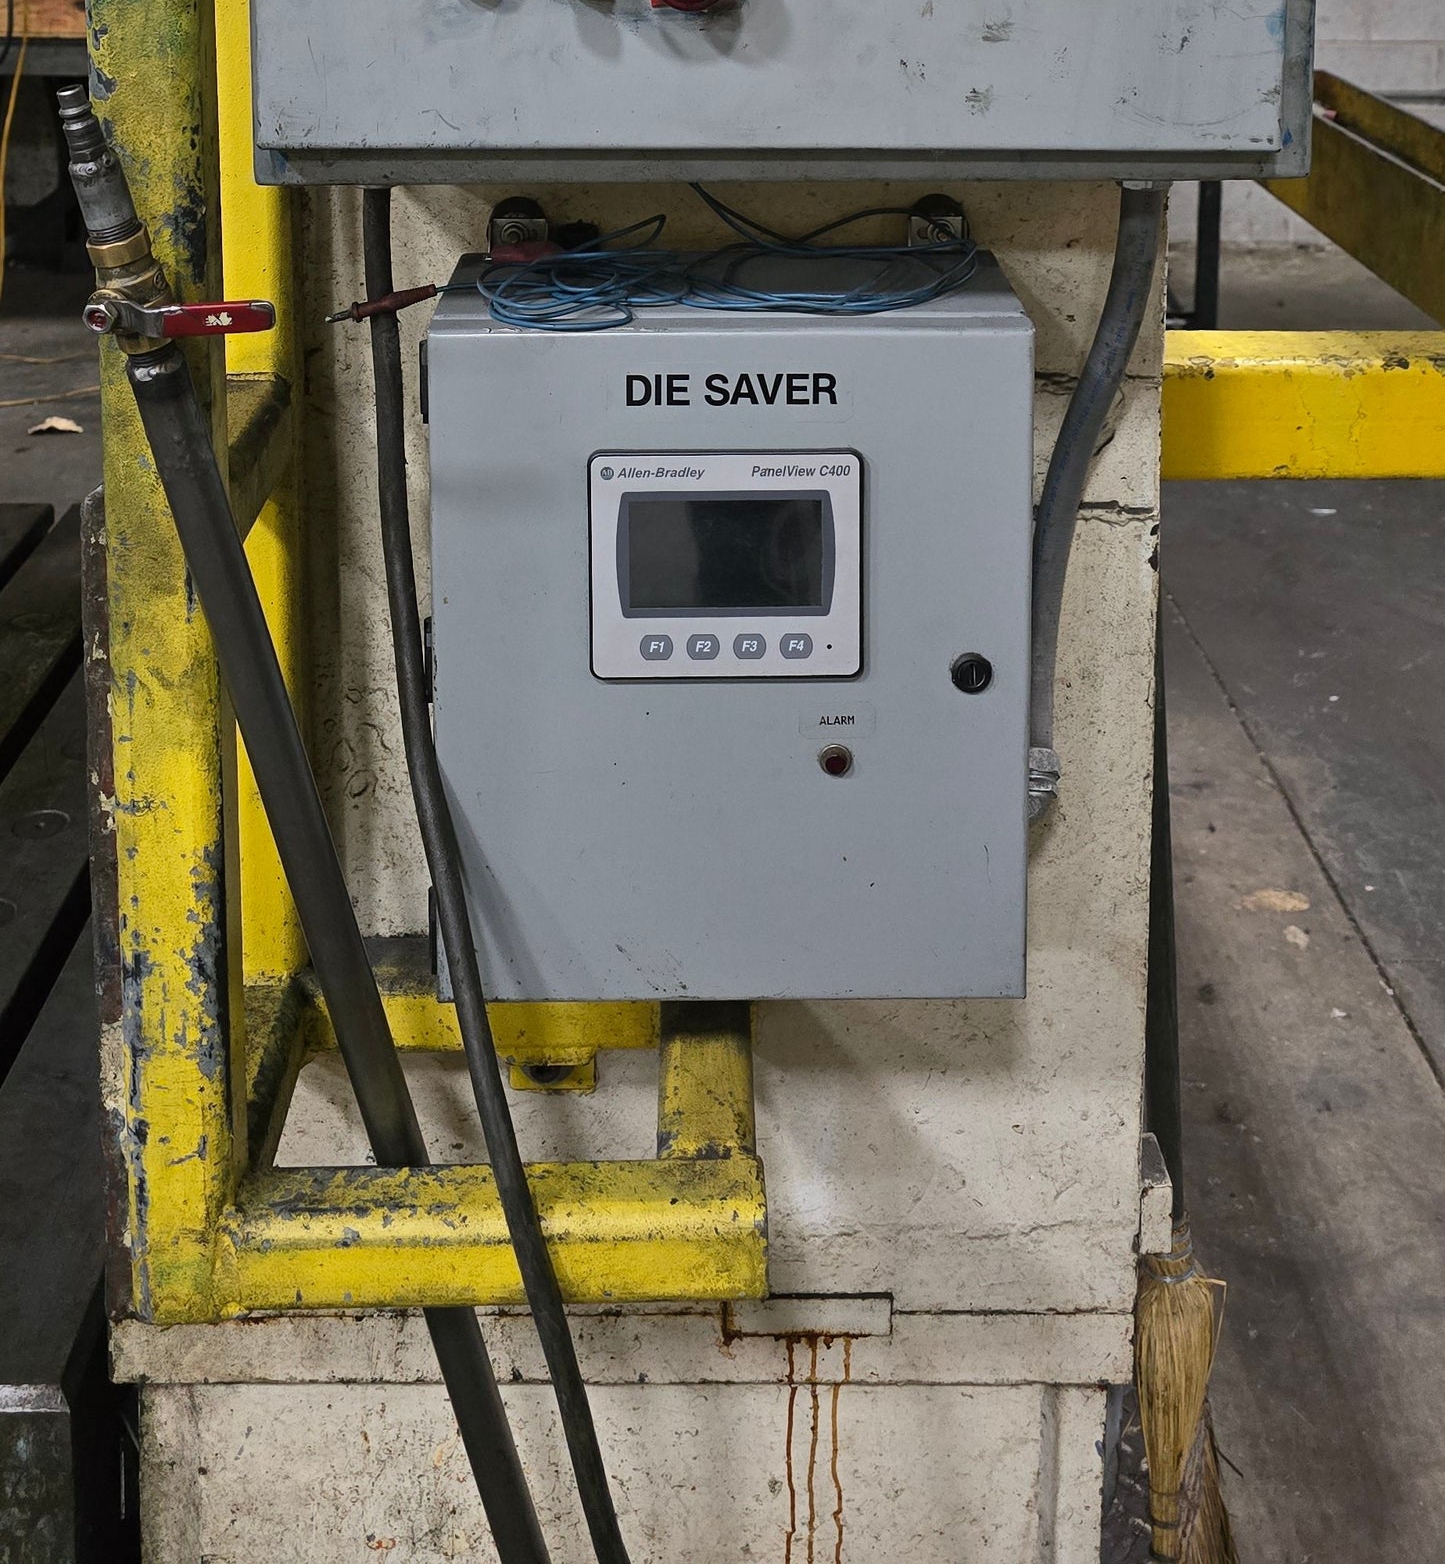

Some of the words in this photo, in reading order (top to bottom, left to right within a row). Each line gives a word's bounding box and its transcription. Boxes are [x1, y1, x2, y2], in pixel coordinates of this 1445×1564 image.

[626, 374, 690, 406] DIE
[704, 373, 838, 405] SAVER
[617, 467, 705, 480] Allen-Bradley
[751, 465, 816, 477] PanelView
[819, 465, 851, 477] C400
[650, 642, 664, 652] F1
[696, 642, 711, 652] F2
[742, 641, 757, 652] F3
[788, 640, 804, 651] F4
[819, 715, 855, 725] ALARM
